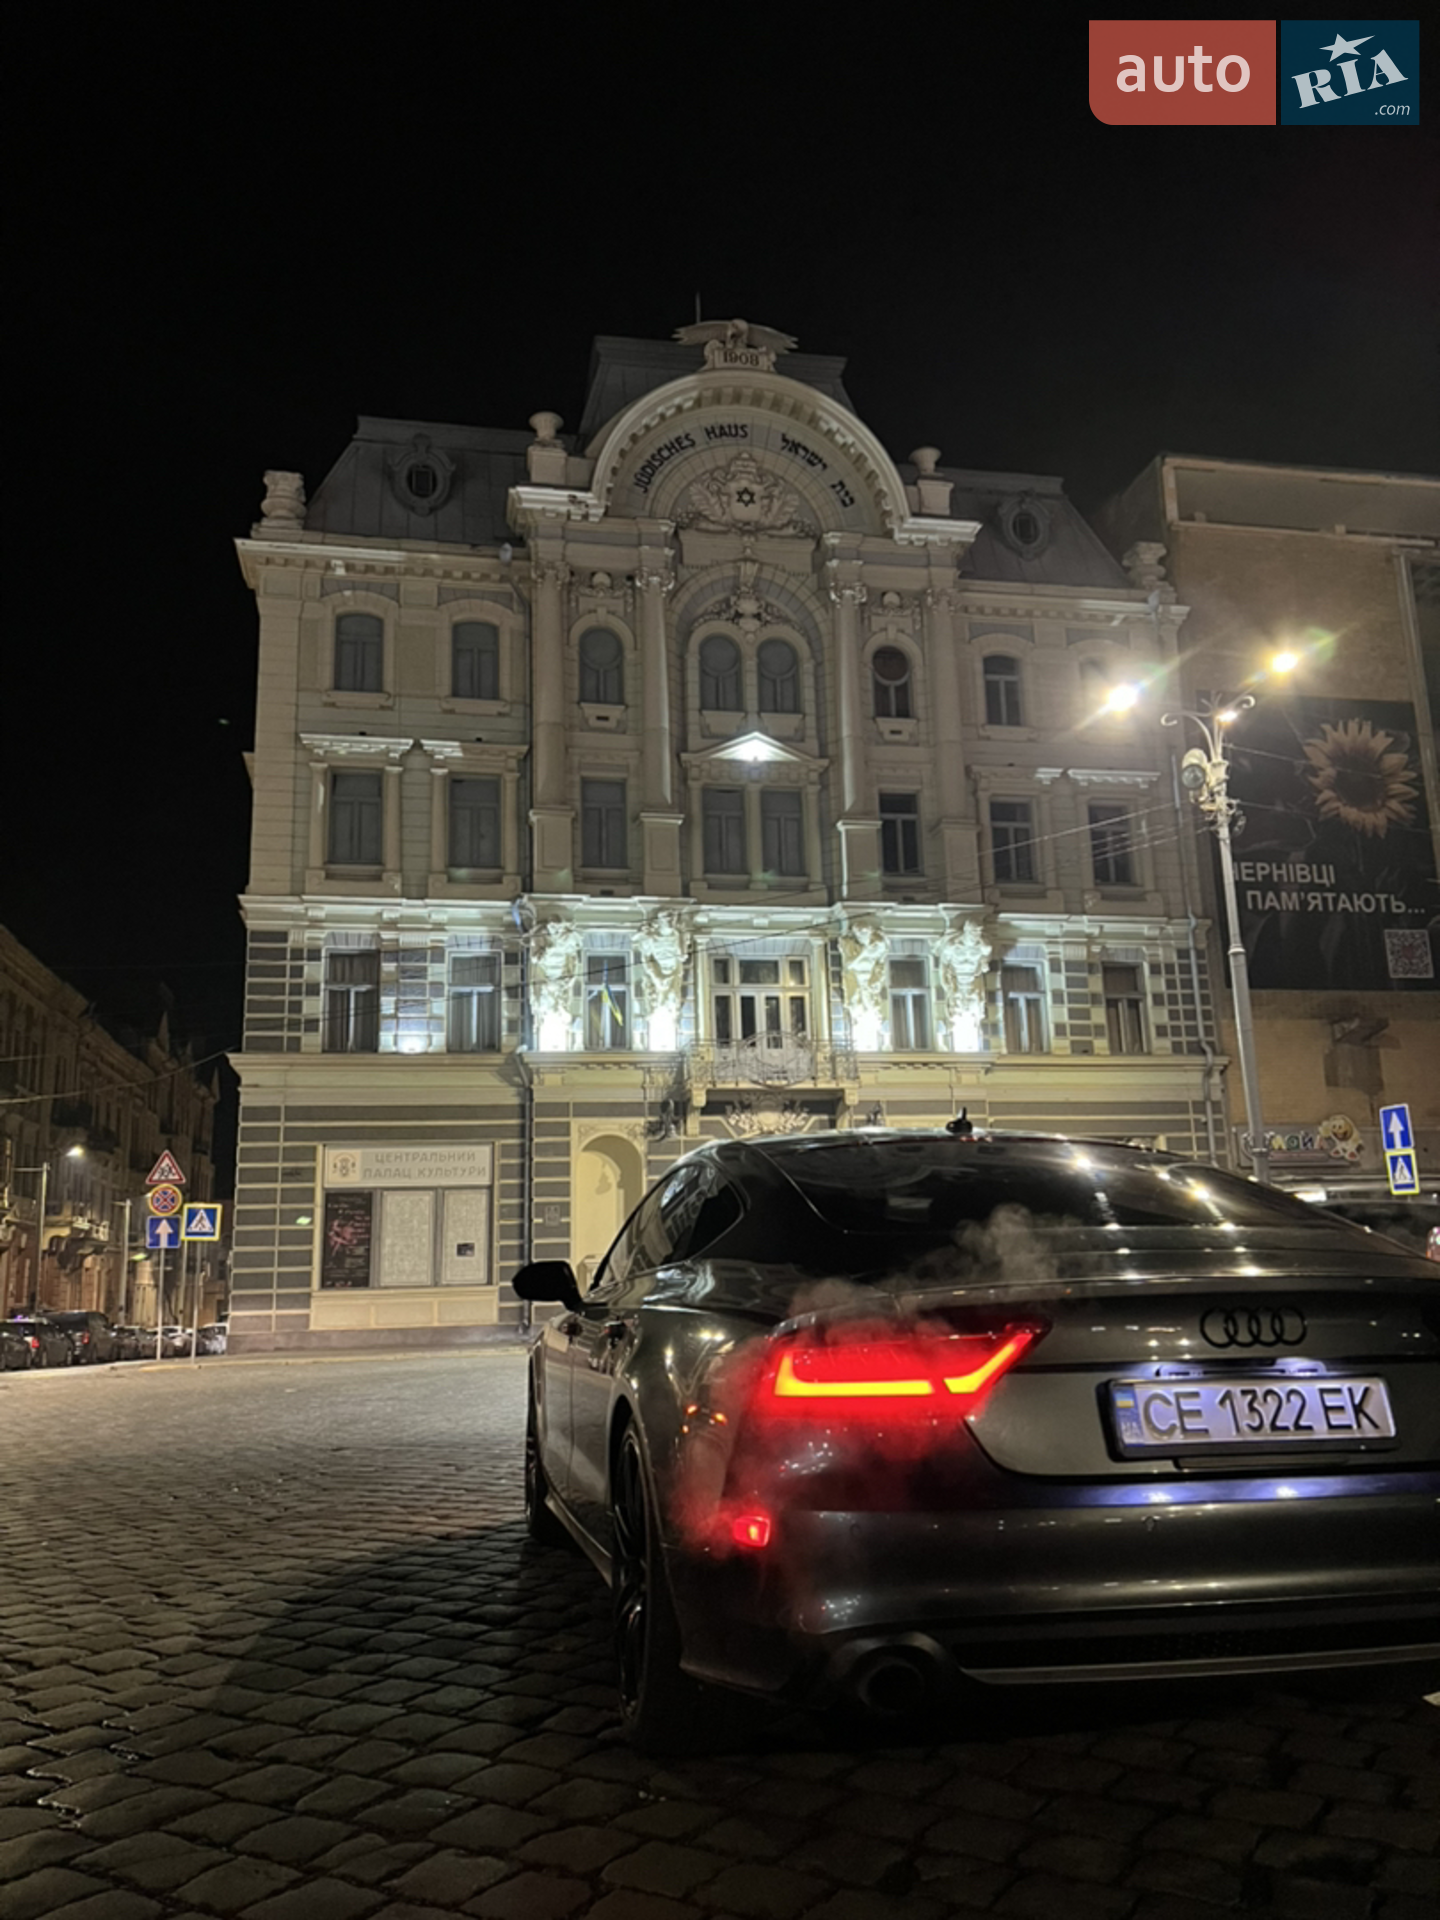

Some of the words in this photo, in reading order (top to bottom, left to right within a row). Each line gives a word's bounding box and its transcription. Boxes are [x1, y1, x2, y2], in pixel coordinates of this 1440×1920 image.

[723, 351, 760, 367] 1908
[704, 424, 749, 440] HAUS
[375, 1150, 476, 1164] ЦЕНТРАЛЬНИЙ
[363, 1168, 412, 1180] ПАЛАЦ
[417, 1166, 487, 1178] КУЛЬТУРИ
[1143, 1390, 1210, 1440] CE
[1216, 1387, 1314, 1435] 1322
[1317, 1386, 1380, 1431] EK
